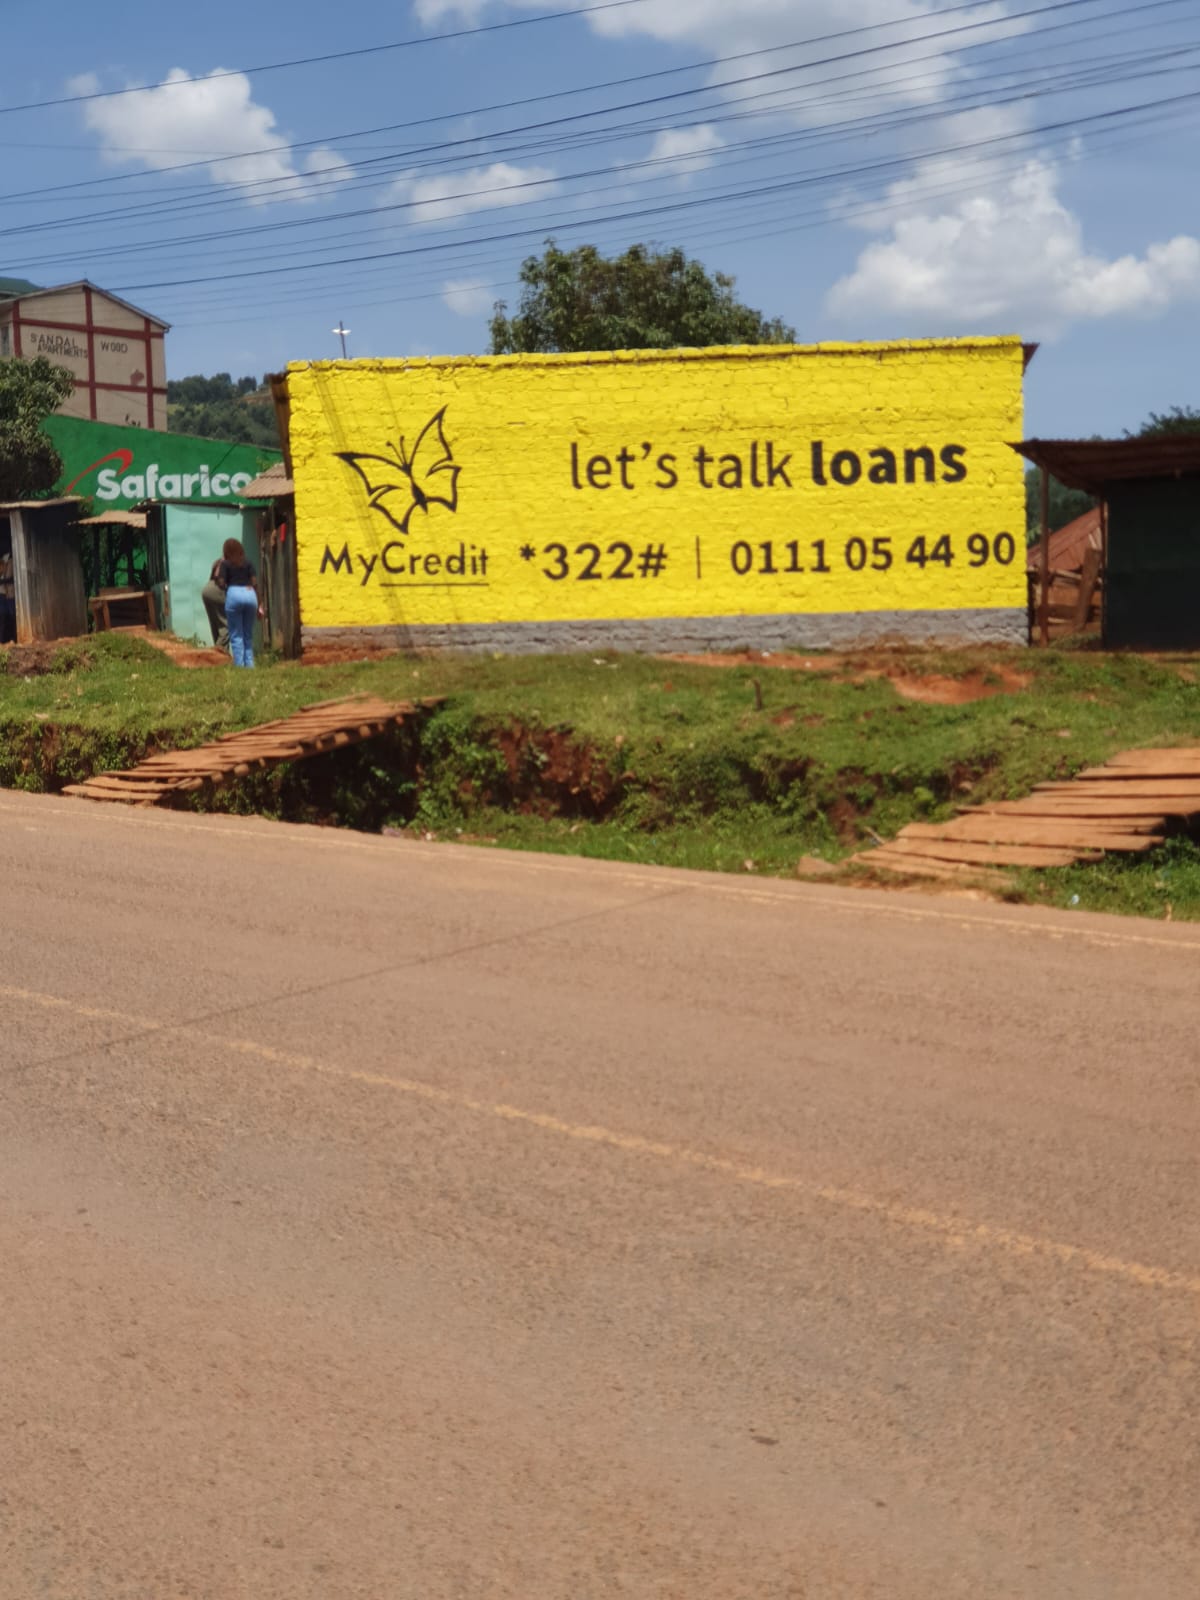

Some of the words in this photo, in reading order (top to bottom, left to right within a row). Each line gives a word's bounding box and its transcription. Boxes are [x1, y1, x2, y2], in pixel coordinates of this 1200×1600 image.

[30, 332, 76, 347] SANDAL
[100, 340, 129, 354] WOOD
[95, 463, 262, 500] Safarico
[570, 441, 679, 490] let's
[693, 440, 793, 490] talk
[810, 439, 968, 487] loans
[319, 540, 489, 587] MyCredit
[730, 539, 832, 575] 0111
[844, 536, 894, 572] 05
[905, 534, 955, 569] 44
[966, 531, 1016, 568] 90
